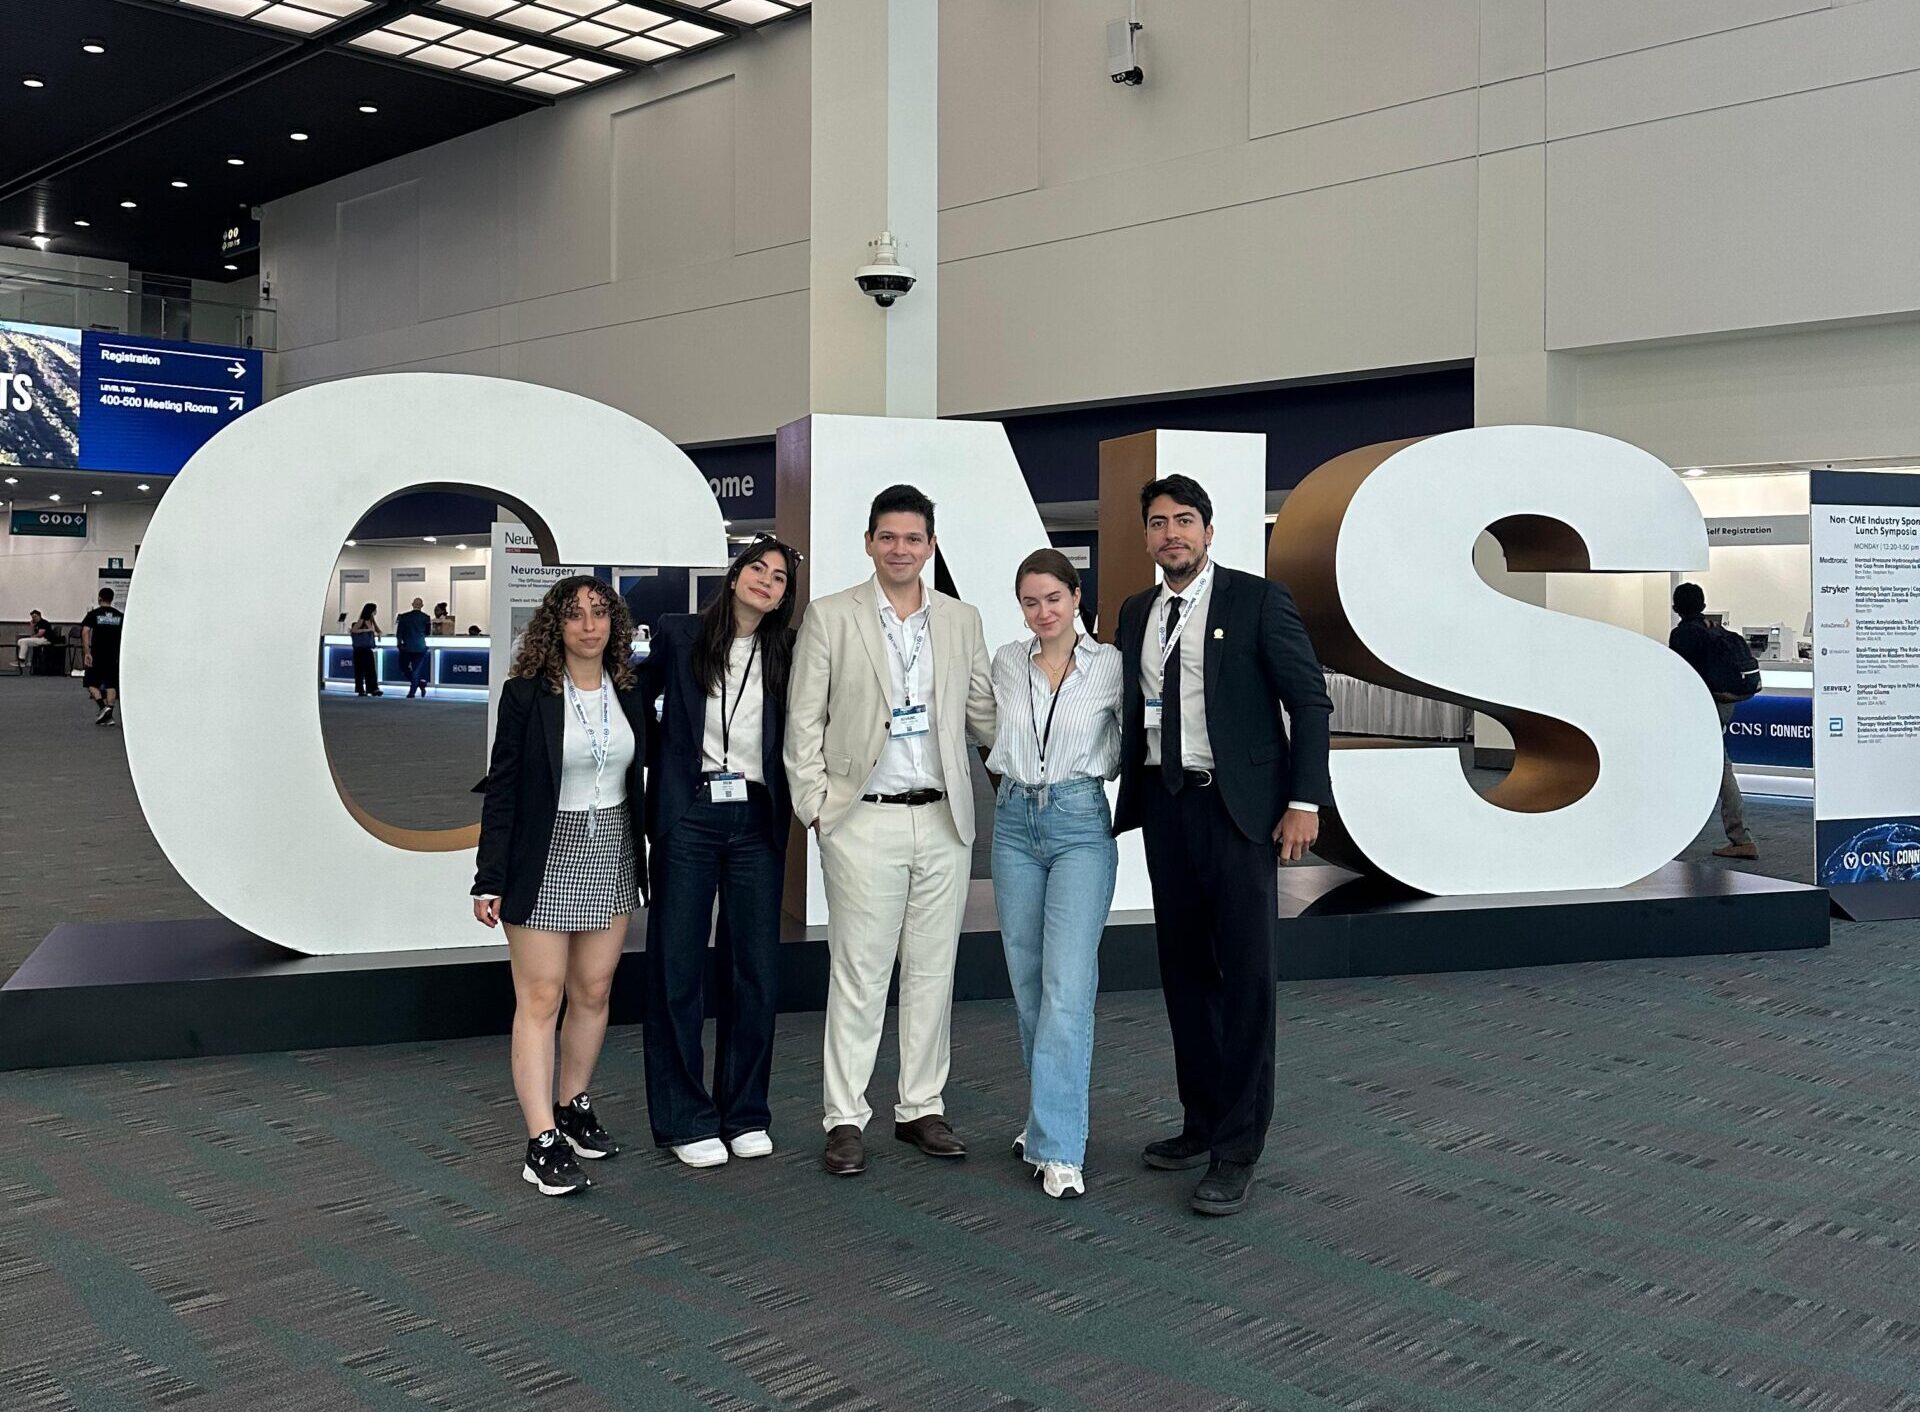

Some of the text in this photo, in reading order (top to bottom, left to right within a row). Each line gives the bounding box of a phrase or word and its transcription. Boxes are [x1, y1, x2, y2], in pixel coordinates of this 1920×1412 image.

[101, 349, 161, 365] Registration
[100, 384, 120, 392] LEVEL
[100, 395, 219, 414] 400-500 Meeting Rooms
[1829, 515, 1866, 524] Non-CME
[1868, 516, 1900, 526] Industry
[1706, 526, 1772, 536] Self Registration
[1856, 527, 1917, 537] Lunch Symposia
[511, 565, 576, 577] Neurosurgery
[1821, 585, 1850, 594] stryker
[119, 372, 1724, 957] CNS
[1729, 722, 1762, 736] CNS
[1861, 851, 1890, 867] CNS
